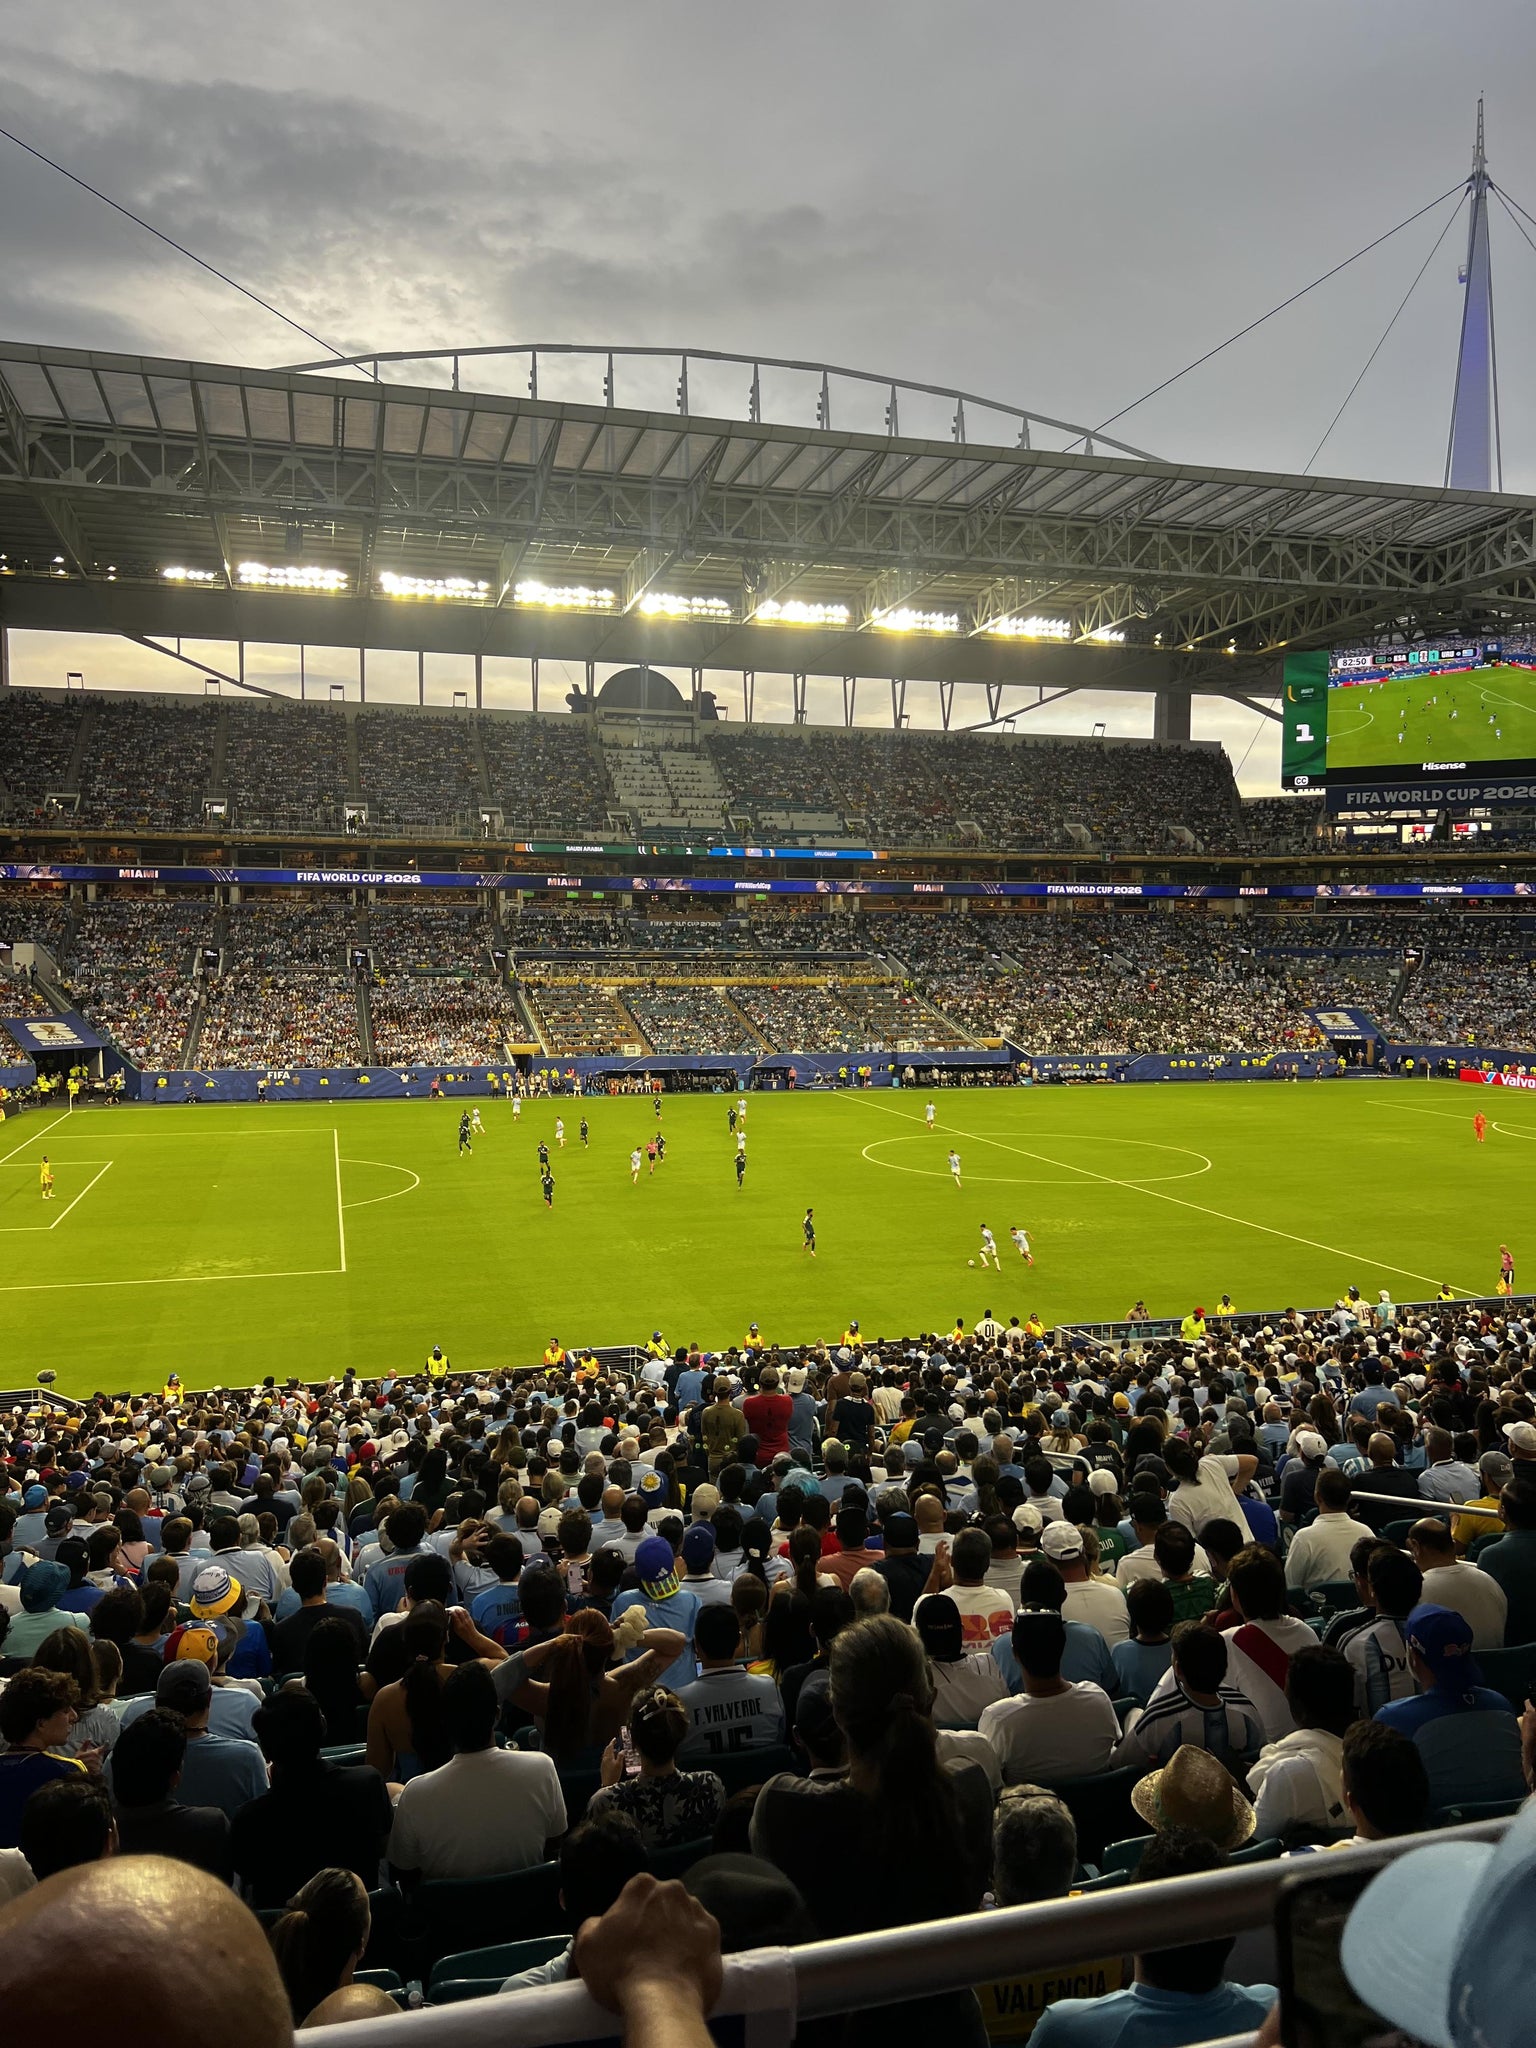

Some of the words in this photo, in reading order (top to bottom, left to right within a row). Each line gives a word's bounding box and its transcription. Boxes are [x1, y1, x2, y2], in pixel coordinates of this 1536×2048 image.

[1342, 657, 1367, 667] 82:50
[1295, 724, 1315, 742] 1
[1422, 762, 1467, 771] Hisense
[1295, 777, 1308, 785] CC
[1346, 791, 1381, 805] FIFA
[1382, 789, 1443, 804] WORLD
[1446, 788, 1480, 801] CUP
[119, 869, 158, 878] MIAMI
[297, 872, 321, 881] FIFA
[321, 873, 360, 882] WORLD
[362, 874, 383, 882] CUP
[384, 874, 421, 883] 2026
[547, 877, 582, 887] MIAMI
[913, 884, 943, 892] MIAMI
[1047, 885, 1065, 893] FIFA
[1113, 886, 1142, 894] 2026
[1239, 887, 1268, 895] MIAMI
[267, 1071, 290, 1080] FIFA
[1501, 1073, 1536, 1089] Valvo
[985, 1324, 995, 1337] 01
[694, 1697, 763, 1726] F.VALVERDE
[993, 1969, 1107, 2015] VALENCIA
